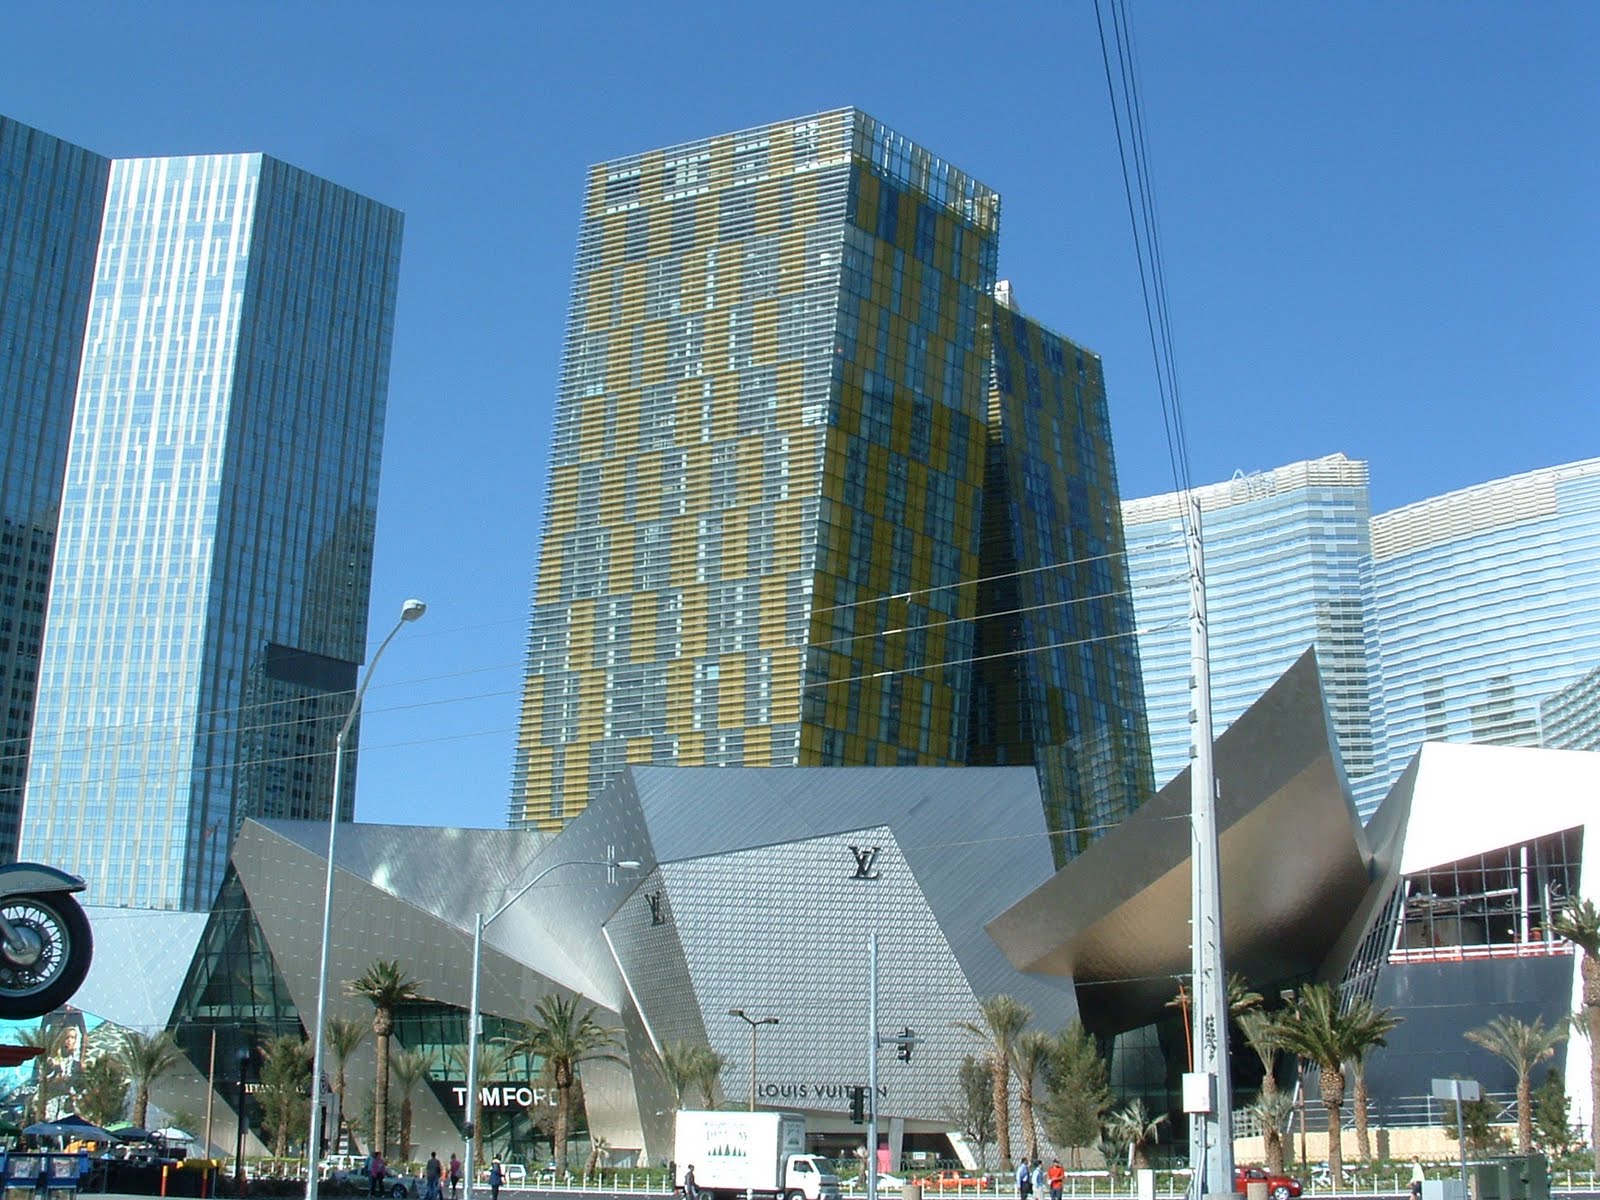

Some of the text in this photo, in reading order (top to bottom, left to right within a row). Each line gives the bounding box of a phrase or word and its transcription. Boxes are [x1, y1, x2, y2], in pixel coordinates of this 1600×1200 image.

[452, 1087, 501, 1106] TM
[758, 1084, 888, 1099] LOUIS VUITN
